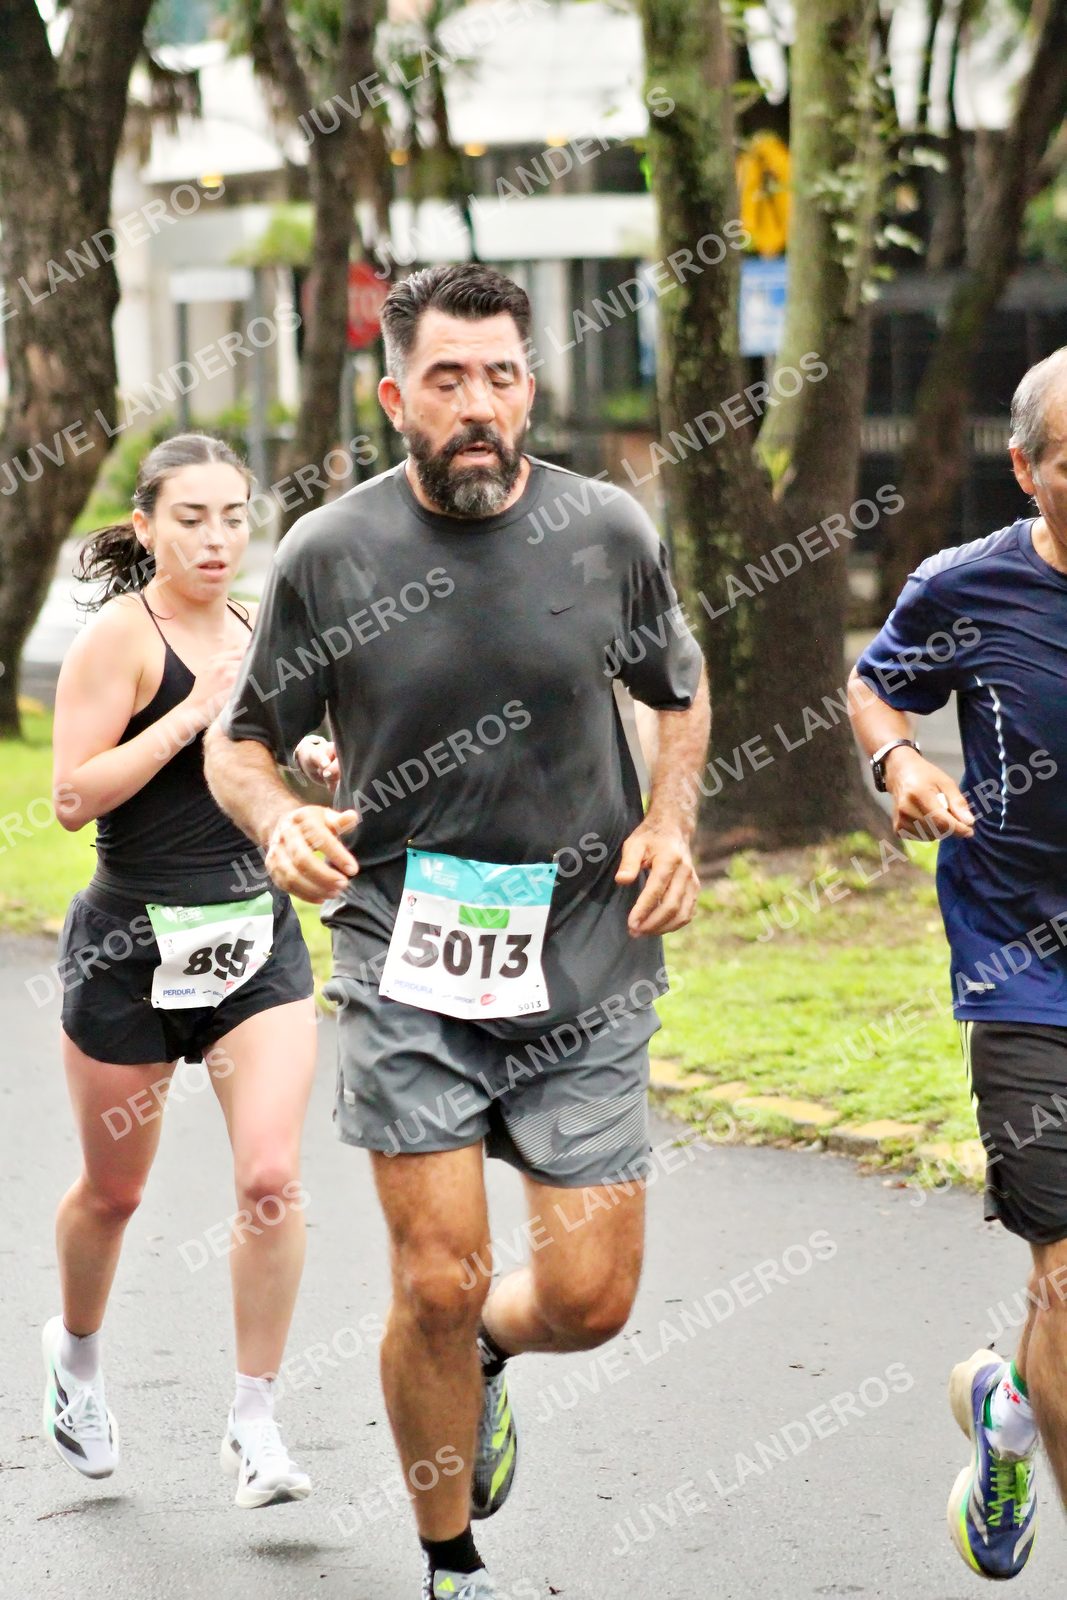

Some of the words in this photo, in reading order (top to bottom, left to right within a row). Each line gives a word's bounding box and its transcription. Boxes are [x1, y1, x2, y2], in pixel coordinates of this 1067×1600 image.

[182, 938, 256, 981] 895
[400, 921, 532, 979] 5013
[162, 988, 196, 996] PERDURA
[517, 1000, 542, 1012] 5013
